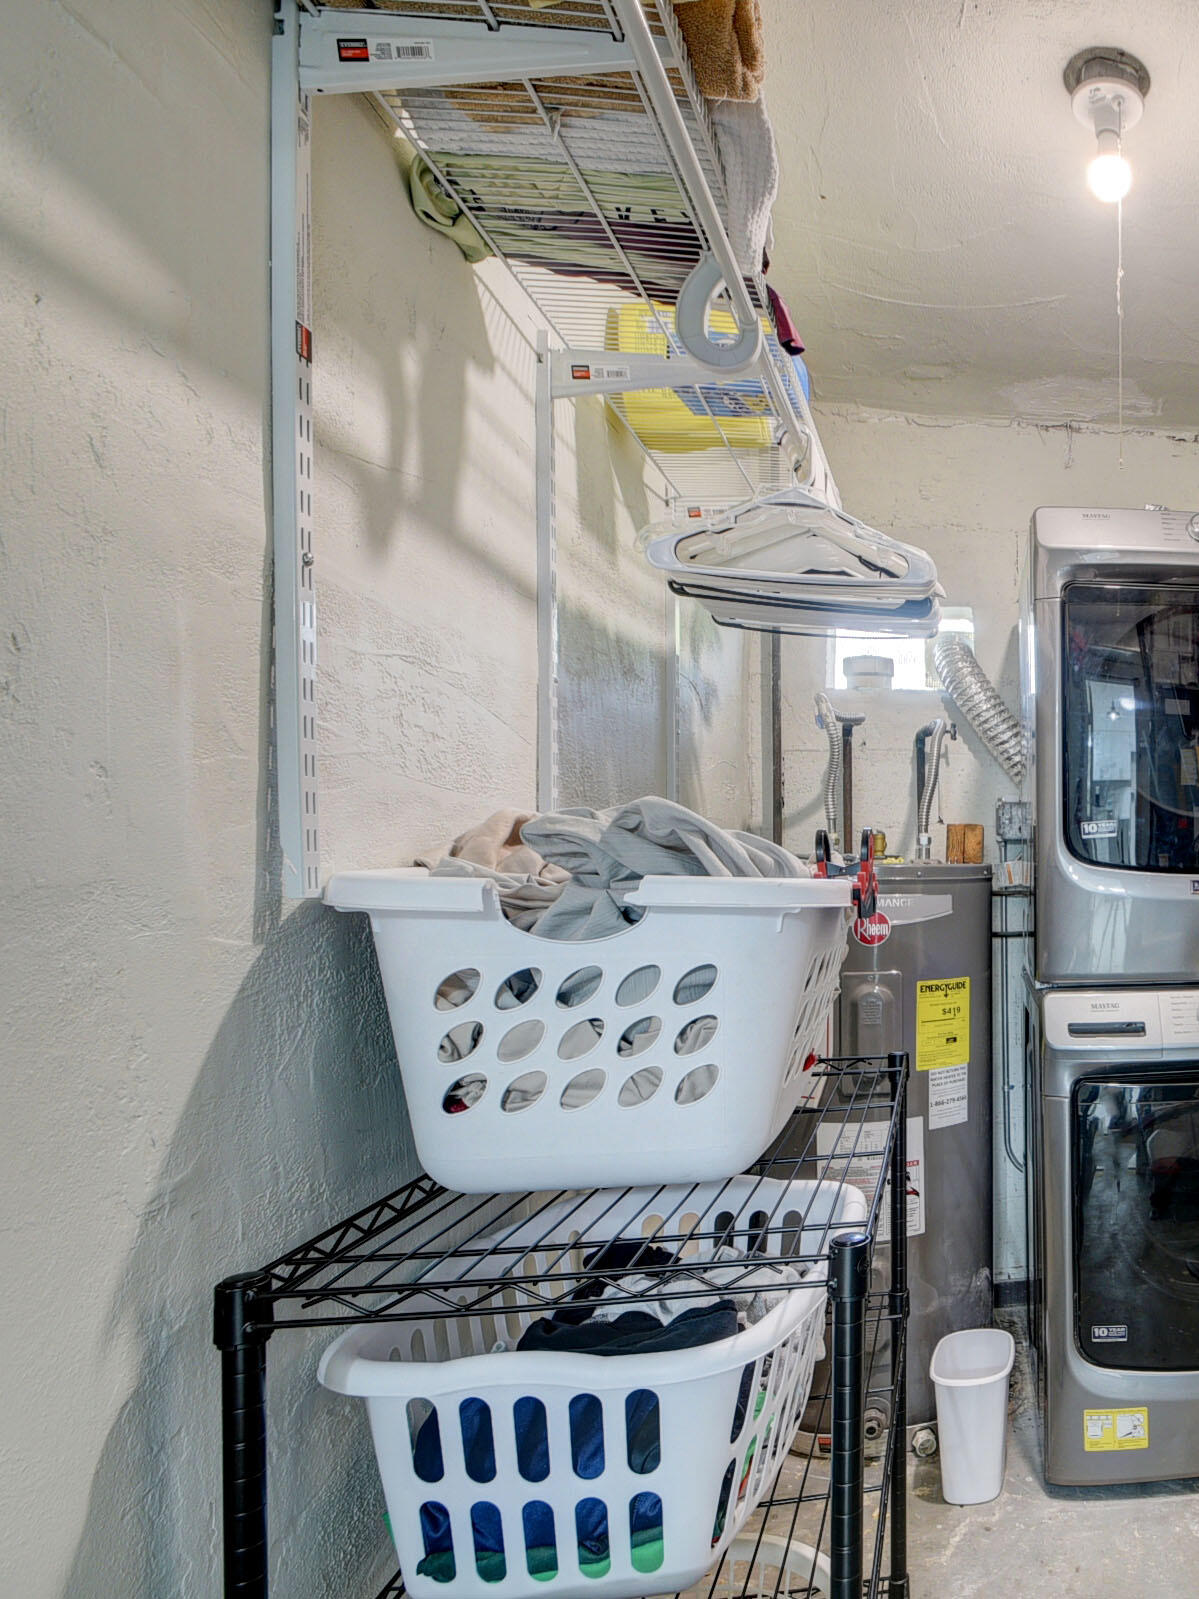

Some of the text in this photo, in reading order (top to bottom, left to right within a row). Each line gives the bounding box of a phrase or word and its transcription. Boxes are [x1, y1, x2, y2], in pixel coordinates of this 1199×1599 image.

[1083, 823, 1098, 833] 10
[857, 918, 889, 940] Rheem
[1090, 1002, 1120, 1010] MAYTAG
[1093, 1327, 1108, 1337] 10
